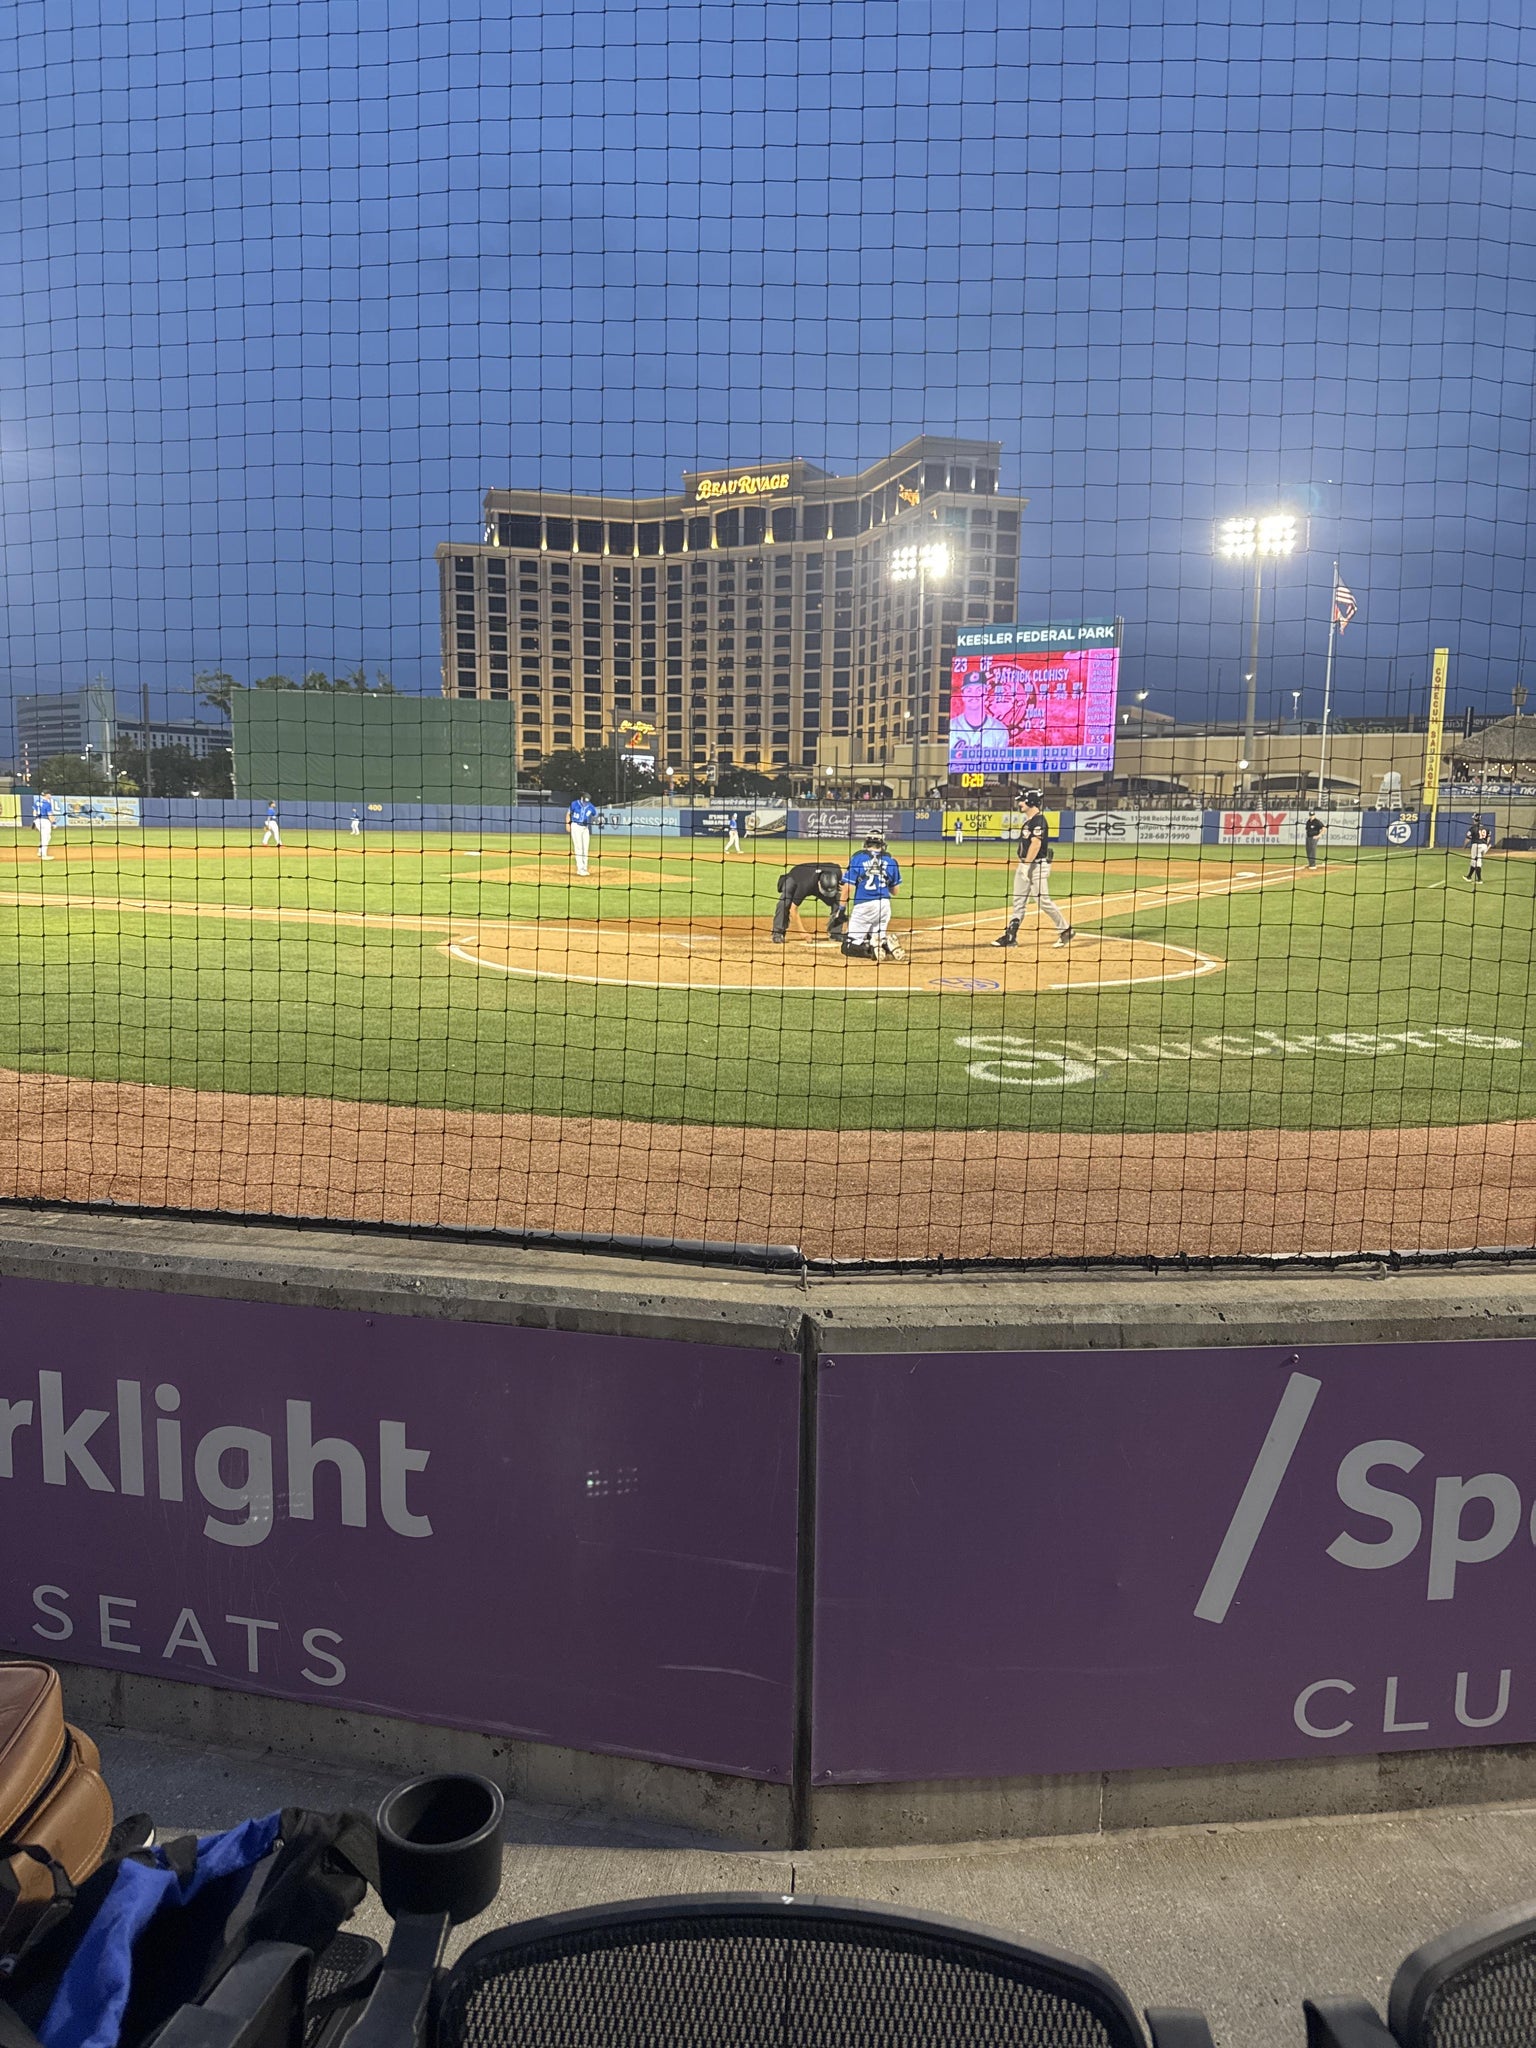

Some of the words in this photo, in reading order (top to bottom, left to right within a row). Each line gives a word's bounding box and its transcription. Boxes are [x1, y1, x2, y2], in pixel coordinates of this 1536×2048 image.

[696, 479, 738, 501] BEAU
[738, 473, 790, 494] RIVAGE
[957, 632, 1013, 647] KEESLER
[1016, 628, 1075, 643] FEDERAL
[1078, 625, 1114, 640] PARK
[954, 657, 968, 673] 23
[994, 669, 1031, 684] PATRICK
[1033, 667, 1069, 682] CLOHISY
[961, 773, 985, 788] 0:28
[622, 816, 677, 826] MISSISSIPPI
[807, 812, 828, 828] Gulf
[829, 814, 851, 825] Coast
[915, 812, 930, 820] 350
[965, 814, 993, 822] LUCKY
[1399, 813, 1419, 822] 325
[969, 821, 988, 829] ONE
[1084, 822, 1126, 836] SRS
[1223, 813, 1287, 836] BAY
[1389, 826, 1407, 840] 42
[1325, 1439, 1536, 1600] Sp
[31, 1584, 347, 1687] SEATS
[1293, 1669, 1511, 1738] CLU
